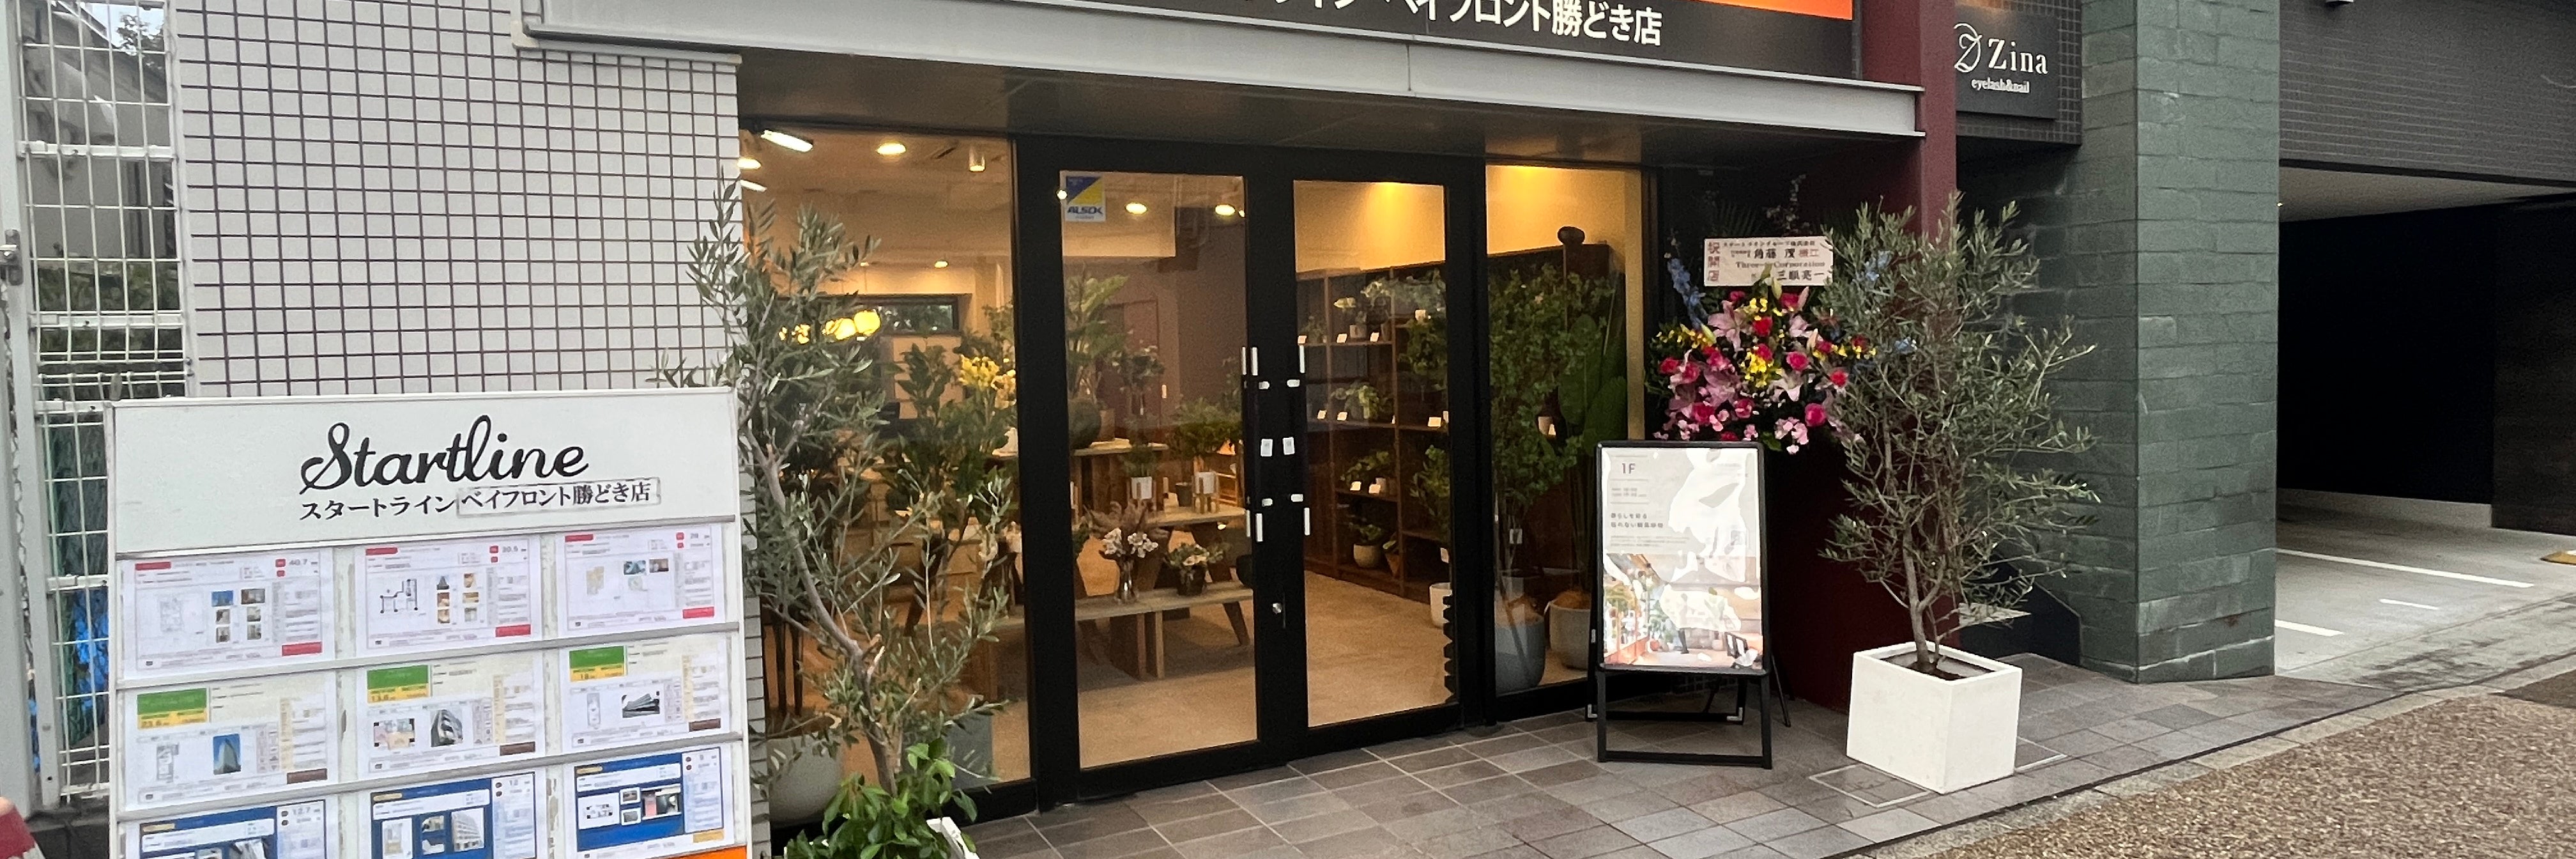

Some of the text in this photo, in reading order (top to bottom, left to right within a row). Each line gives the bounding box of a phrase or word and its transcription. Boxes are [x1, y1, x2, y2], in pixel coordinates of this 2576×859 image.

[1988, 38, 2048, 74] Zina
[1068, 206, 1103, 215] ALSOK
[1774, 261, 1825, 269] Corporation
[299, 414, 588, 495] Startline
[1621, 463, 1636, 474] 1F
